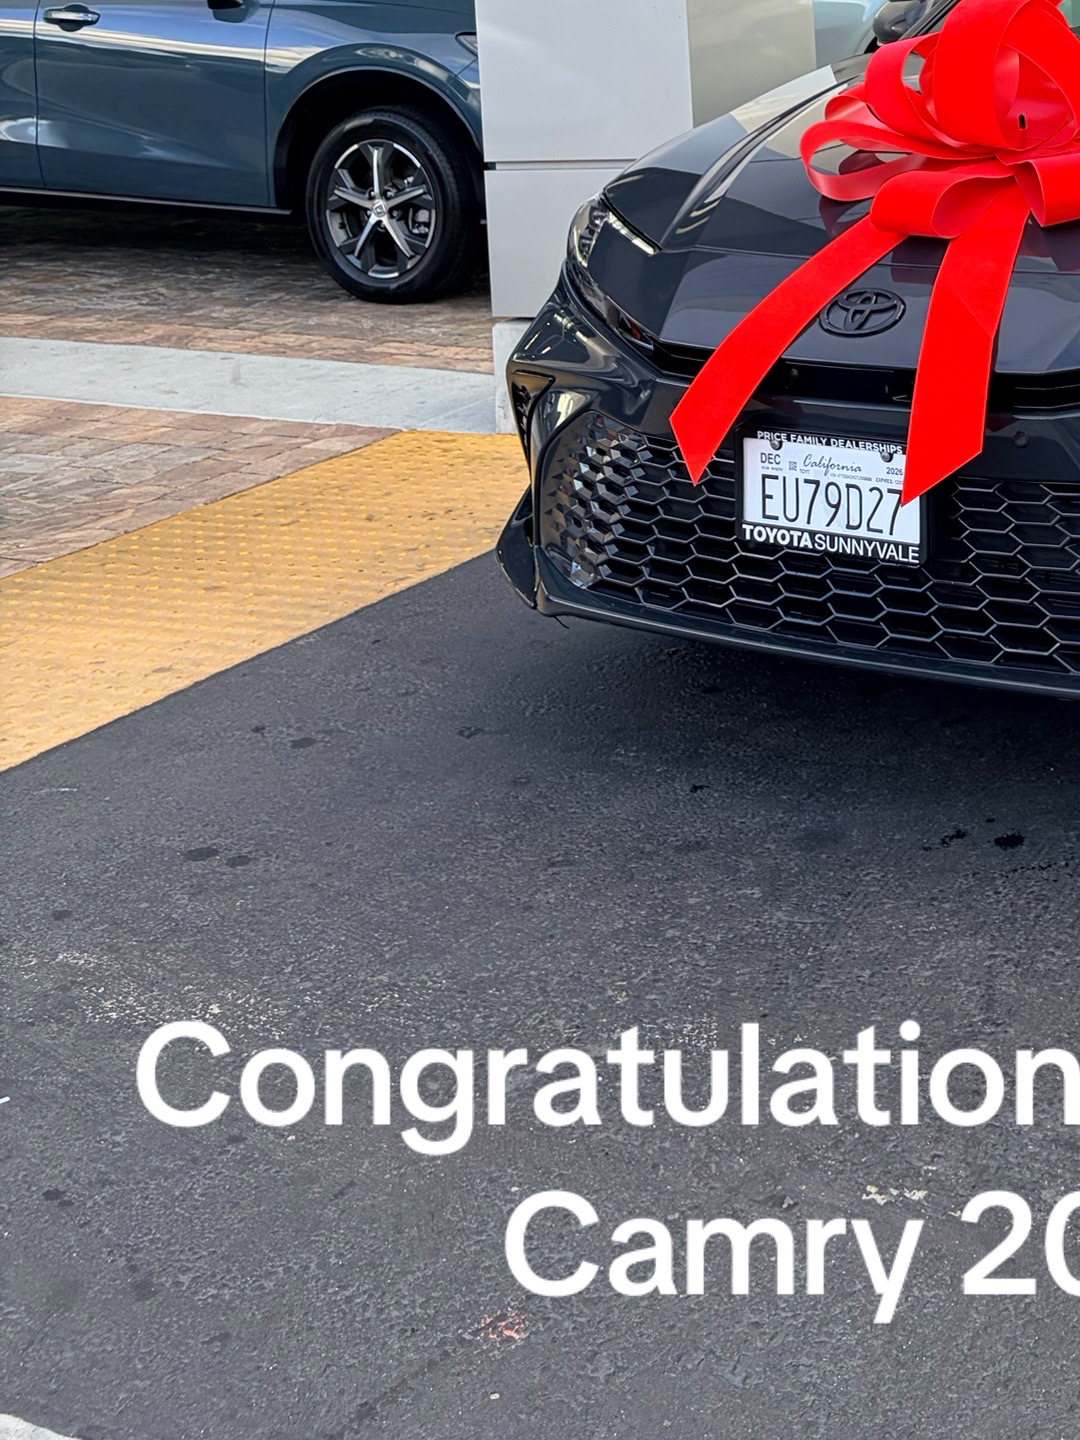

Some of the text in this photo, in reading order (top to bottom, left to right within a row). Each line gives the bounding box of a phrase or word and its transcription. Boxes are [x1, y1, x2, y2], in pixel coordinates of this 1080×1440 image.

[757, 430, 903, 455] PRICE FAMILY DEALERSHIPS
[760, 452, 781, 465] DEC
[803, 453, 862, 477] California
[886, 467, 904, 476] 2026
[761, 473, 904, 536] EU79D27
[742, 524, 920, 564] TOYOTA SUNNYVALE
